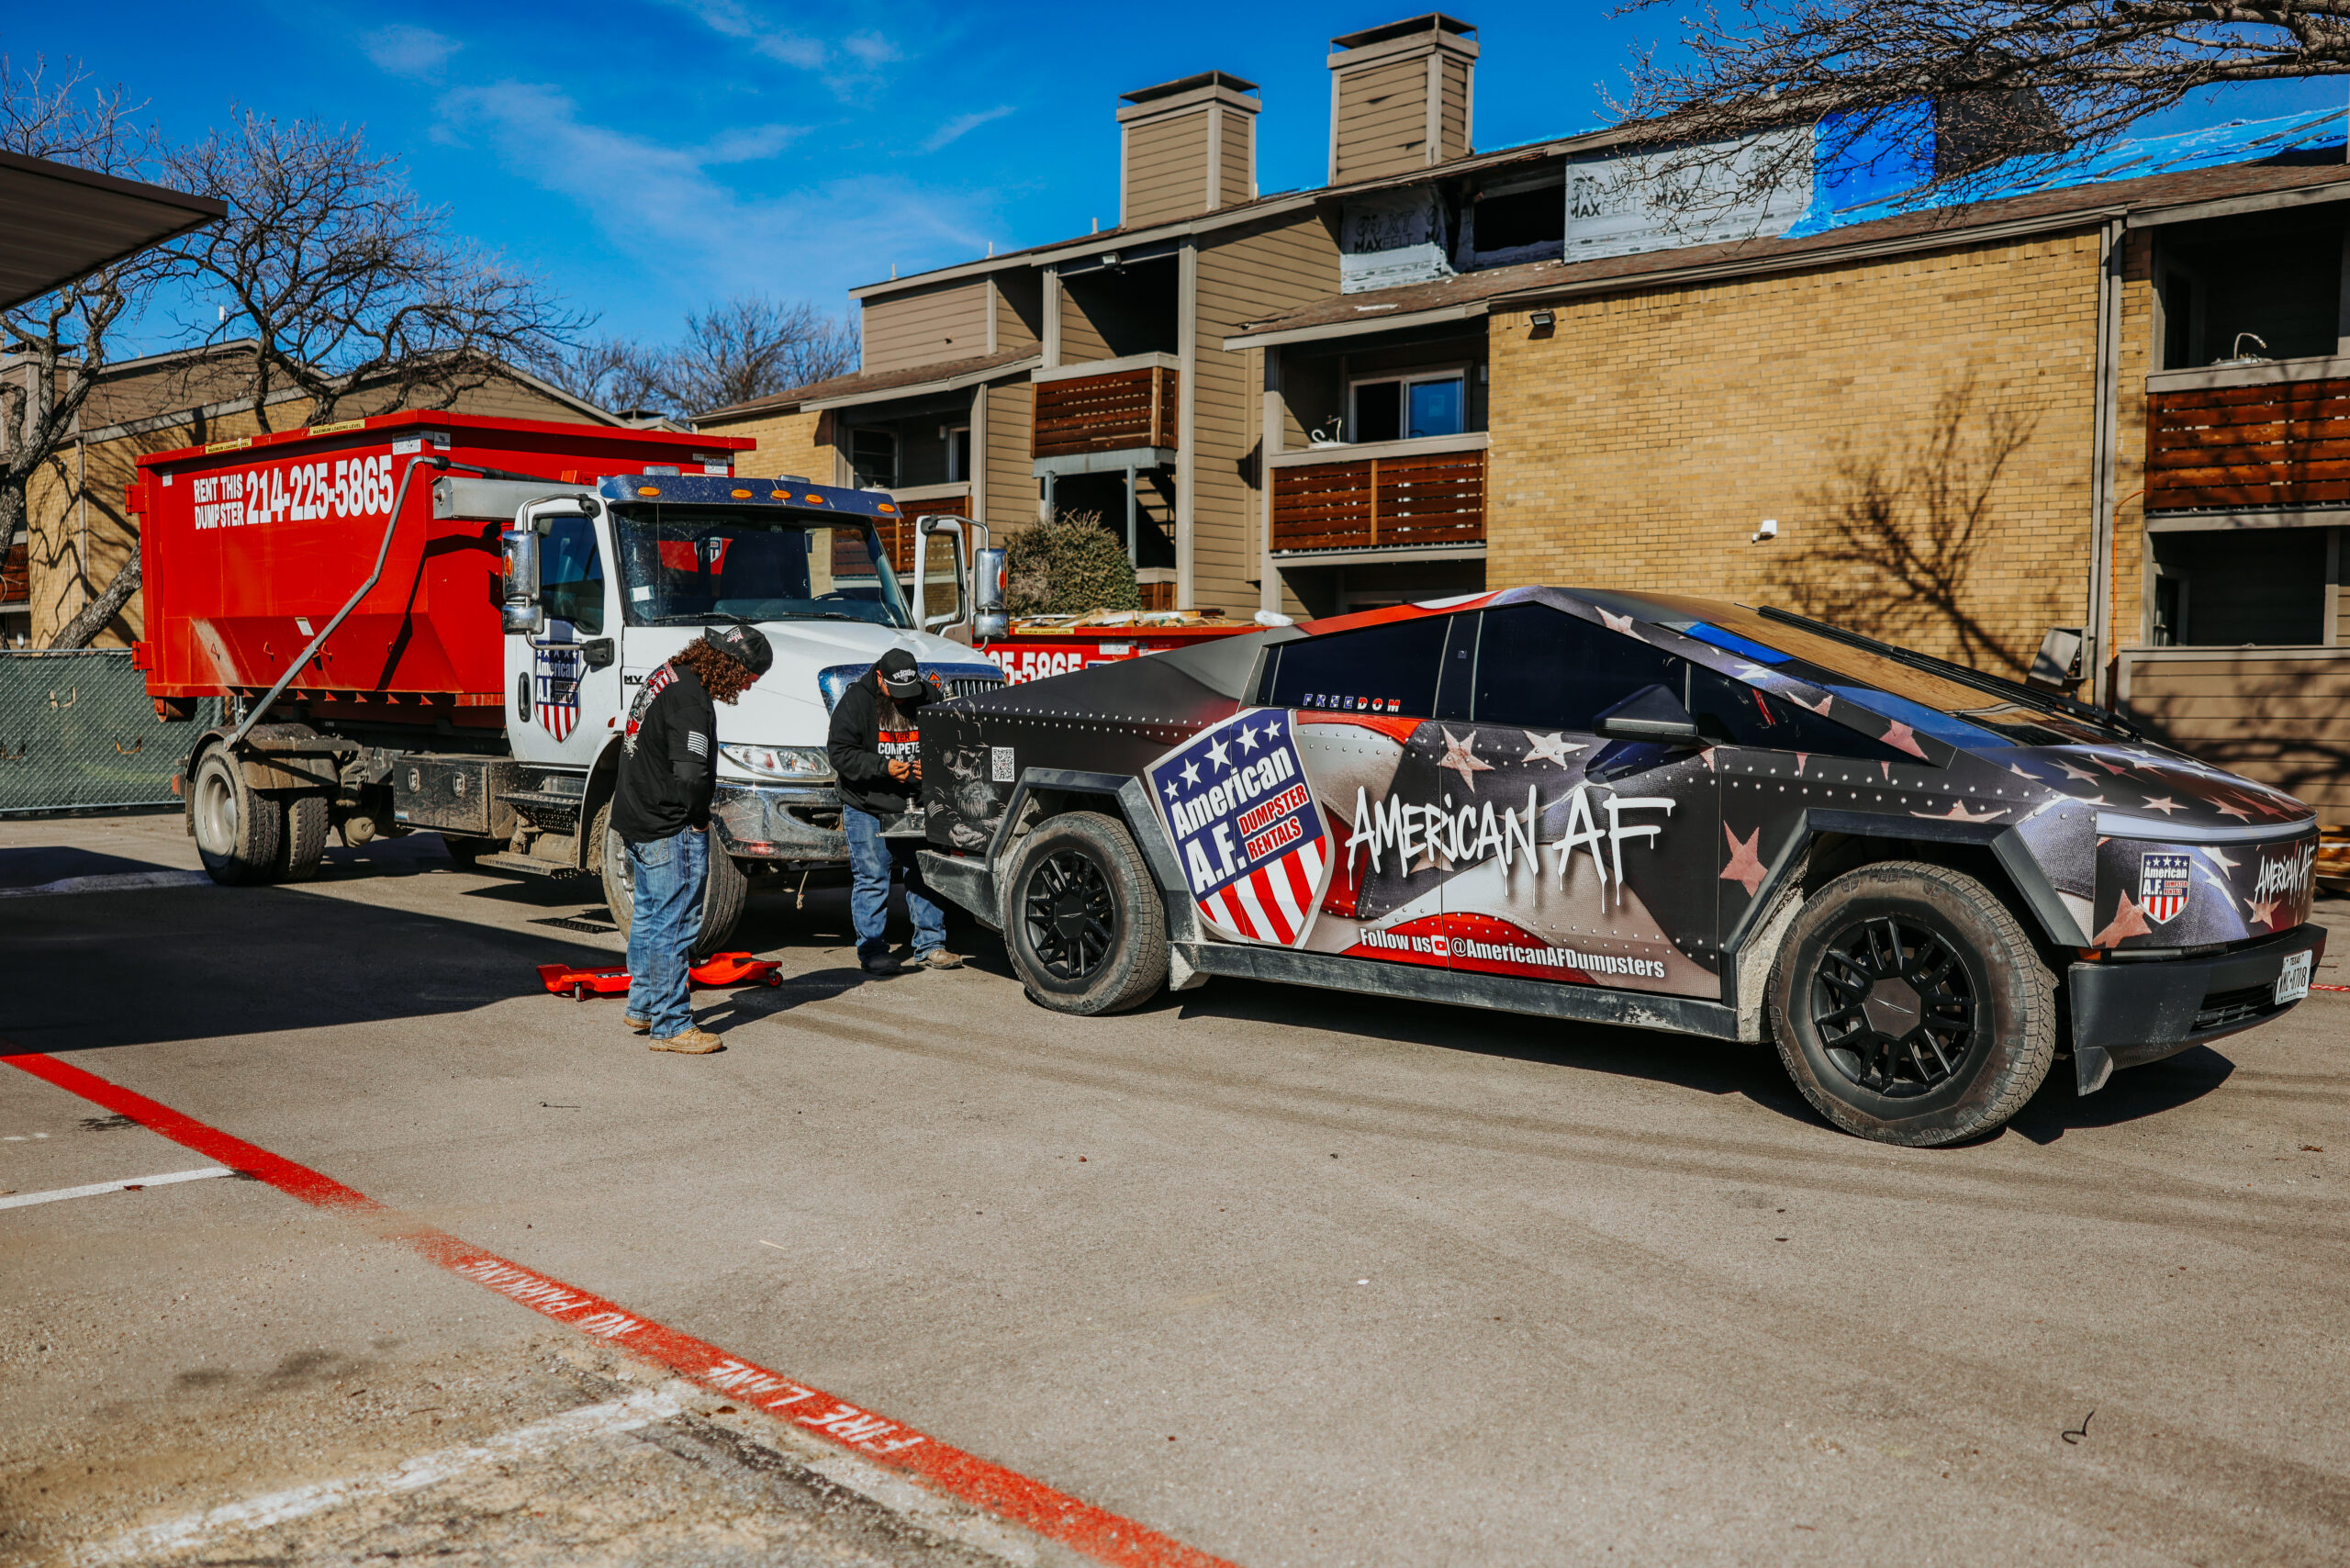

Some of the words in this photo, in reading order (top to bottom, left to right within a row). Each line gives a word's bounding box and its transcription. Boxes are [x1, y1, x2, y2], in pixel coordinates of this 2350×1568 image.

[312, 426, 331, 435] MAXIMUM
[331, 424, 349, 433] LOADING
[349, 422, 362, 431] LEVEL
[207, 445, 224, 454] MAXIMUM
[224, 442, 239, 452] LOADING
[194, 477, 218, 503] RENT
[220, 474, 243, 499] THIS
[246, 454, 395, 525] 214-225-5865
[195, 501, 244, 530] DUMPSTER
[536, 659, 576, 679] American
[1303, 693, 1401, 712] FREEDOM
[878, 742, 921, 755] COMPETE
[1170, 746, 1295, 841] American
[1237, 783, 1310, 836] DUMPSTER
[1246, 816, 1303, 861] RENTALS
[1552, 779, 1676, 914] AF
[1185, 821, 1247, 895] A.F.
[2143, 867, 2187, 879] American
[2143, 879, 2163, 895] A.F.
[2299, 843, 2315, 904] AF
[1360, 927, 1410, 951] Follow
[1413, 936, 1432, 953] us
[1451, 937, 1666, 979] @AmericanAFDumpsters
[2289, 955, 2301, 966] TEXAS
[576, 1312, 642, 1339] NO
[707, 1359, 815, 1408] LANE
[797, 1403, 924, 1454] FIRE
